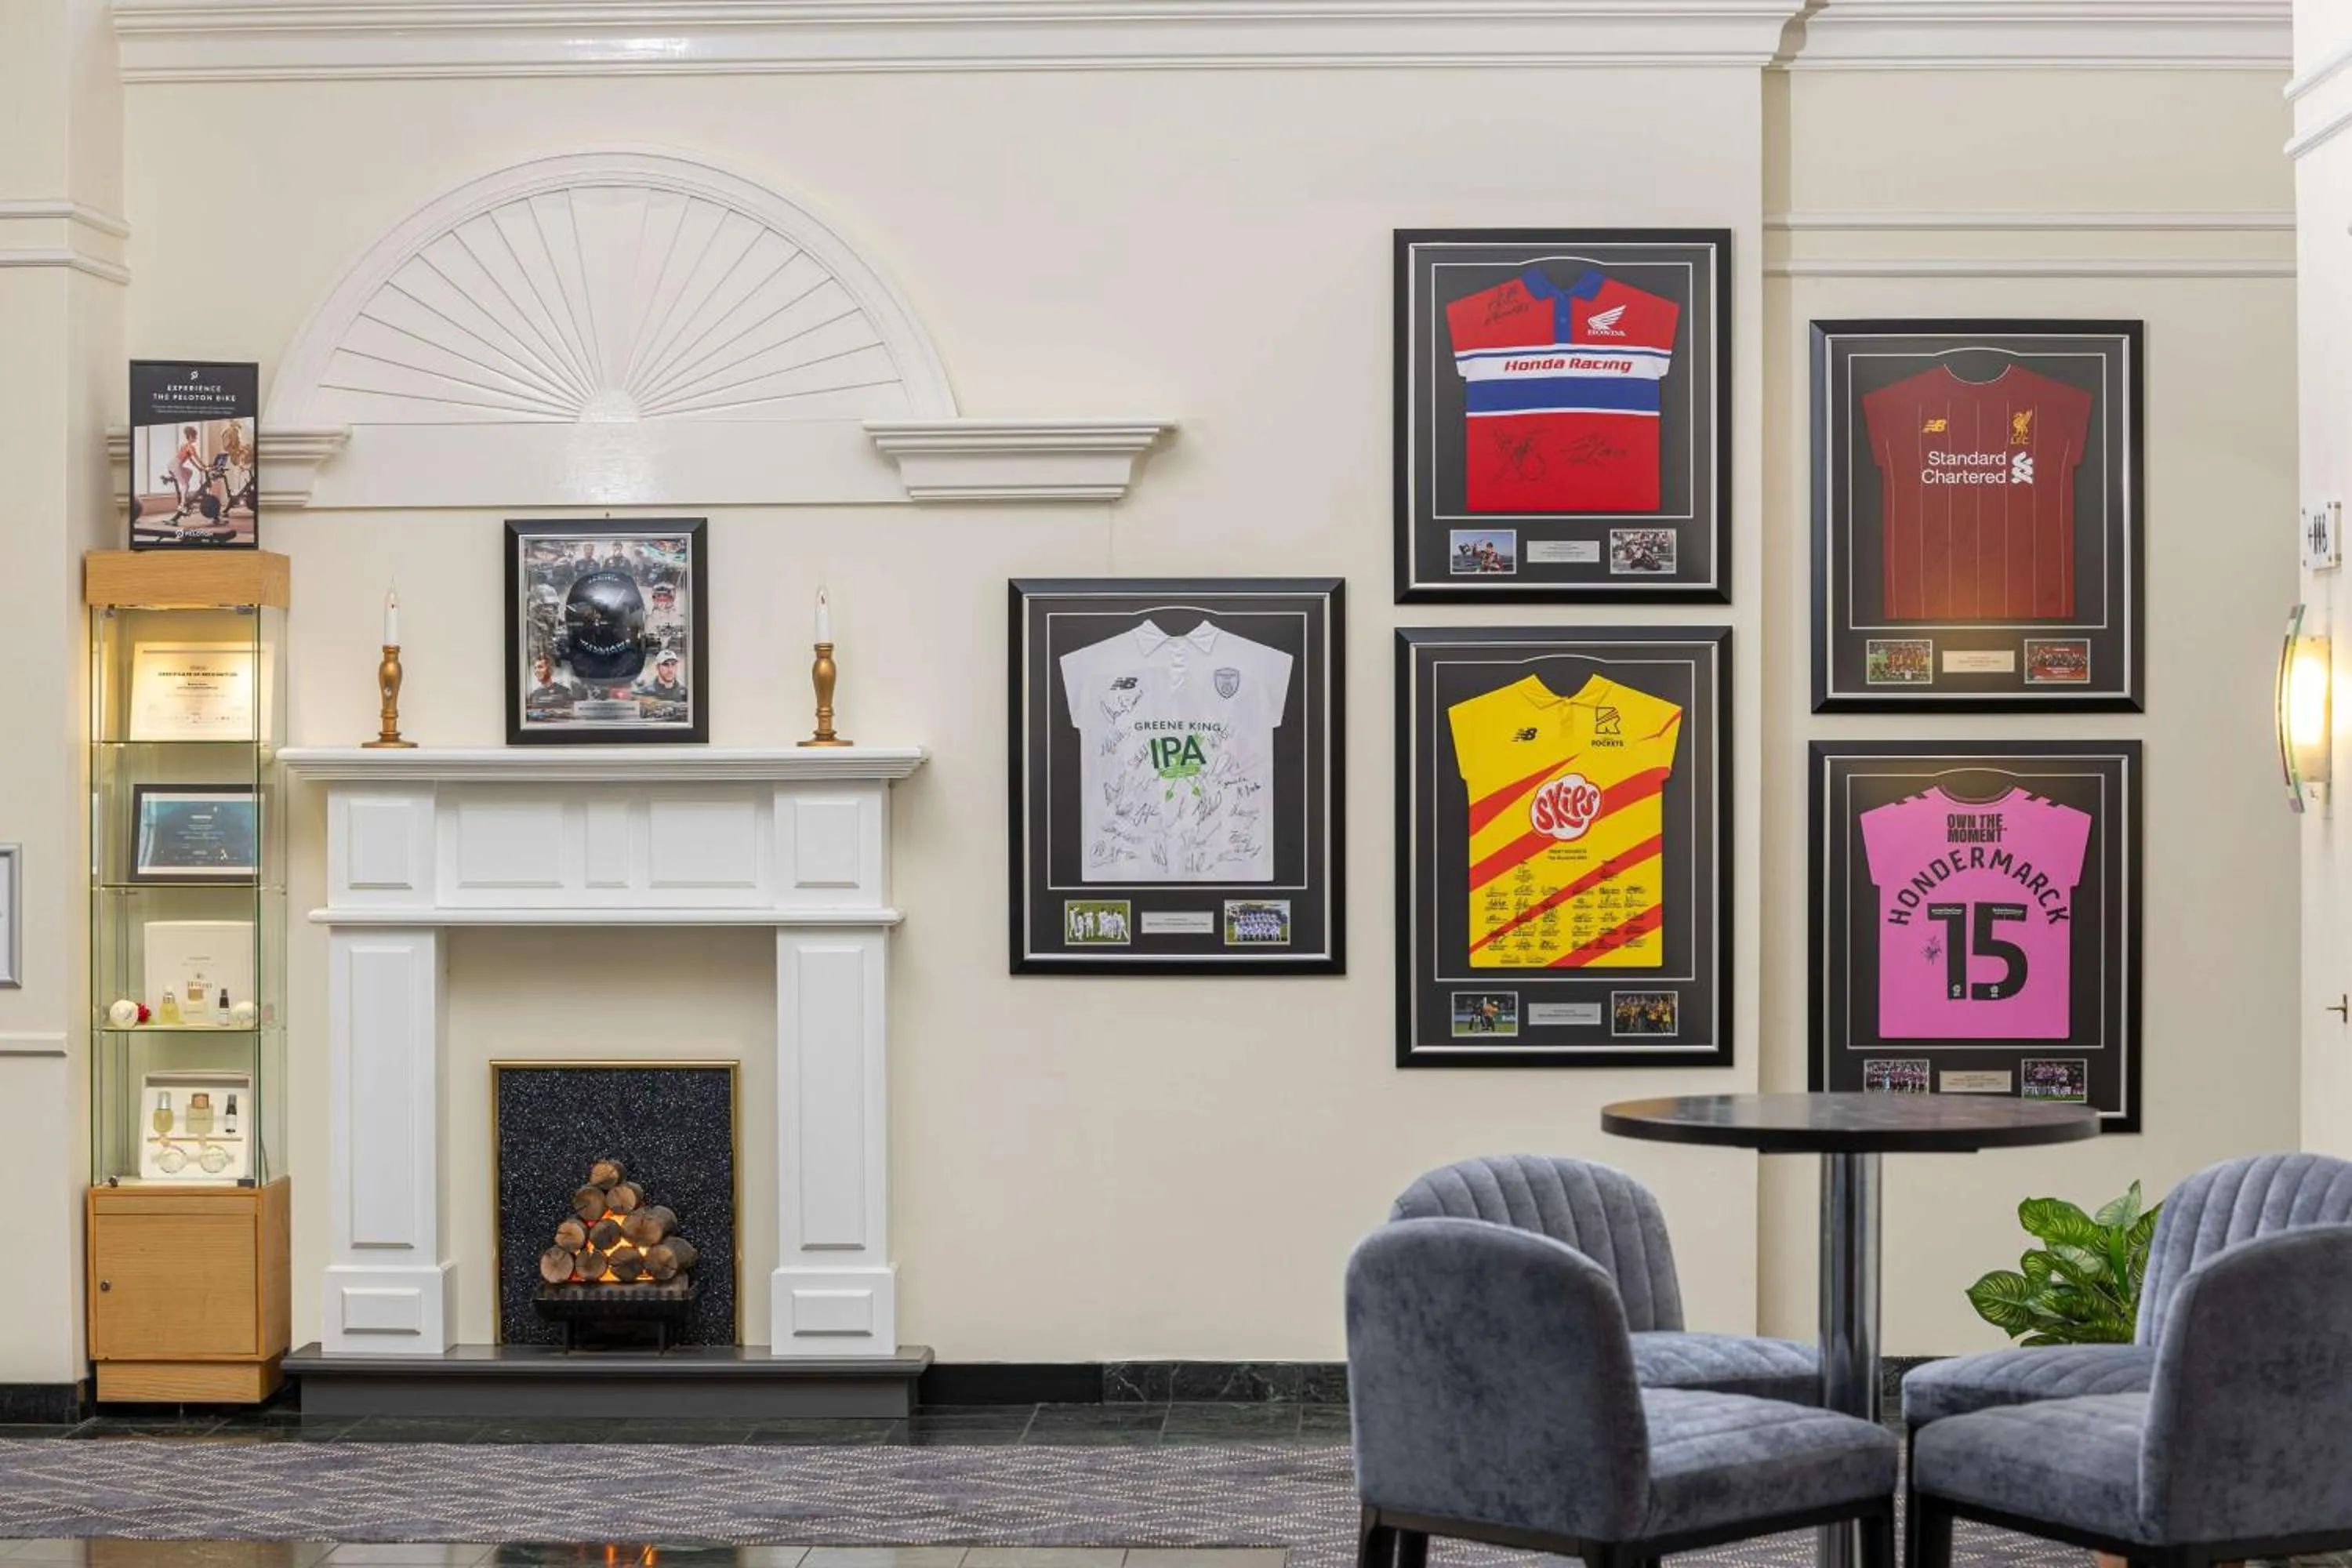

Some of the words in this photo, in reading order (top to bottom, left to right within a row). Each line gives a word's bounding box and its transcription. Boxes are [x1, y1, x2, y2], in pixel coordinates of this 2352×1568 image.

[1504, 358, 1565, 372] Honda
[1569, 358, 1633, 374] Racing
[1928, 451, 2006, 466] Standard
[1922, 469, 2006, 485] Chartered
[1134, 720, 1184, 731] GREENE
[1189, 721, 1221, 731] KING
[1150, 735, 1207, 769] IPA
[1947, 814, 1975, 828] OWN
[1980, 814, 2003, 828] THE
[1947, 829, 2003, 843] MOMENT
[1888, 846, 2070, 926] HONDERMARCK
[1927, 902, 2028, 1001] 15
